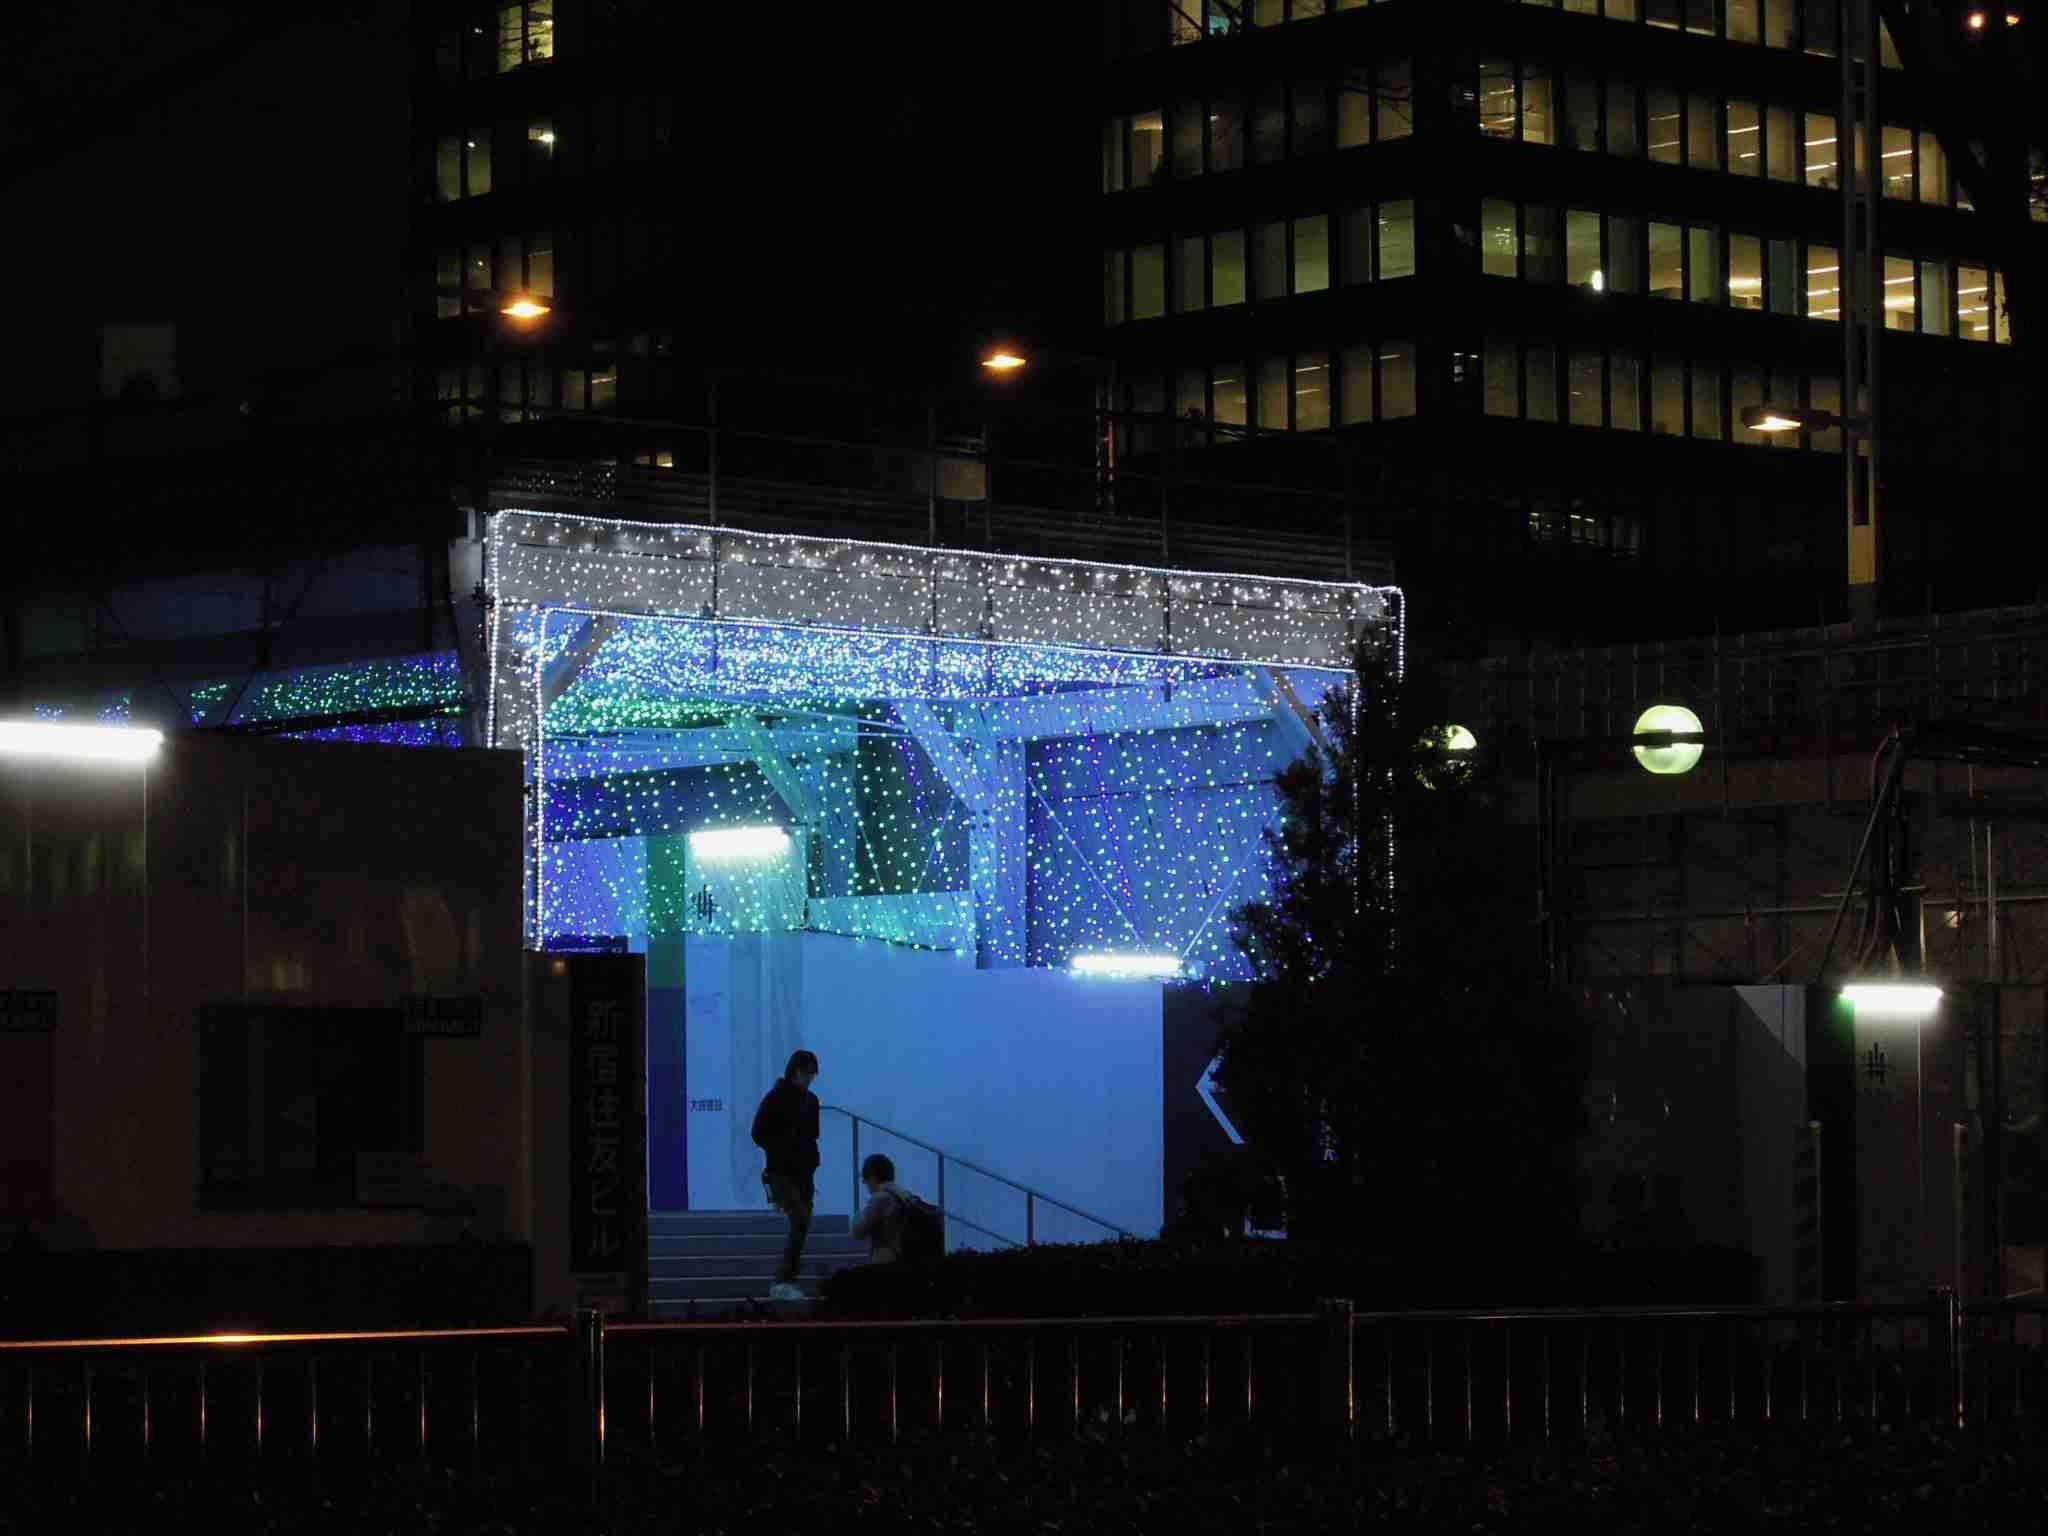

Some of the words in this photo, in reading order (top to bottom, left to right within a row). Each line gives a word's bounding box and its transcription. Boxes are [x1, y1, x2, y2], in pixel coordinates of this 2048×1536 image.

[584, 999, 624, 1257] 新宿住友ビル
